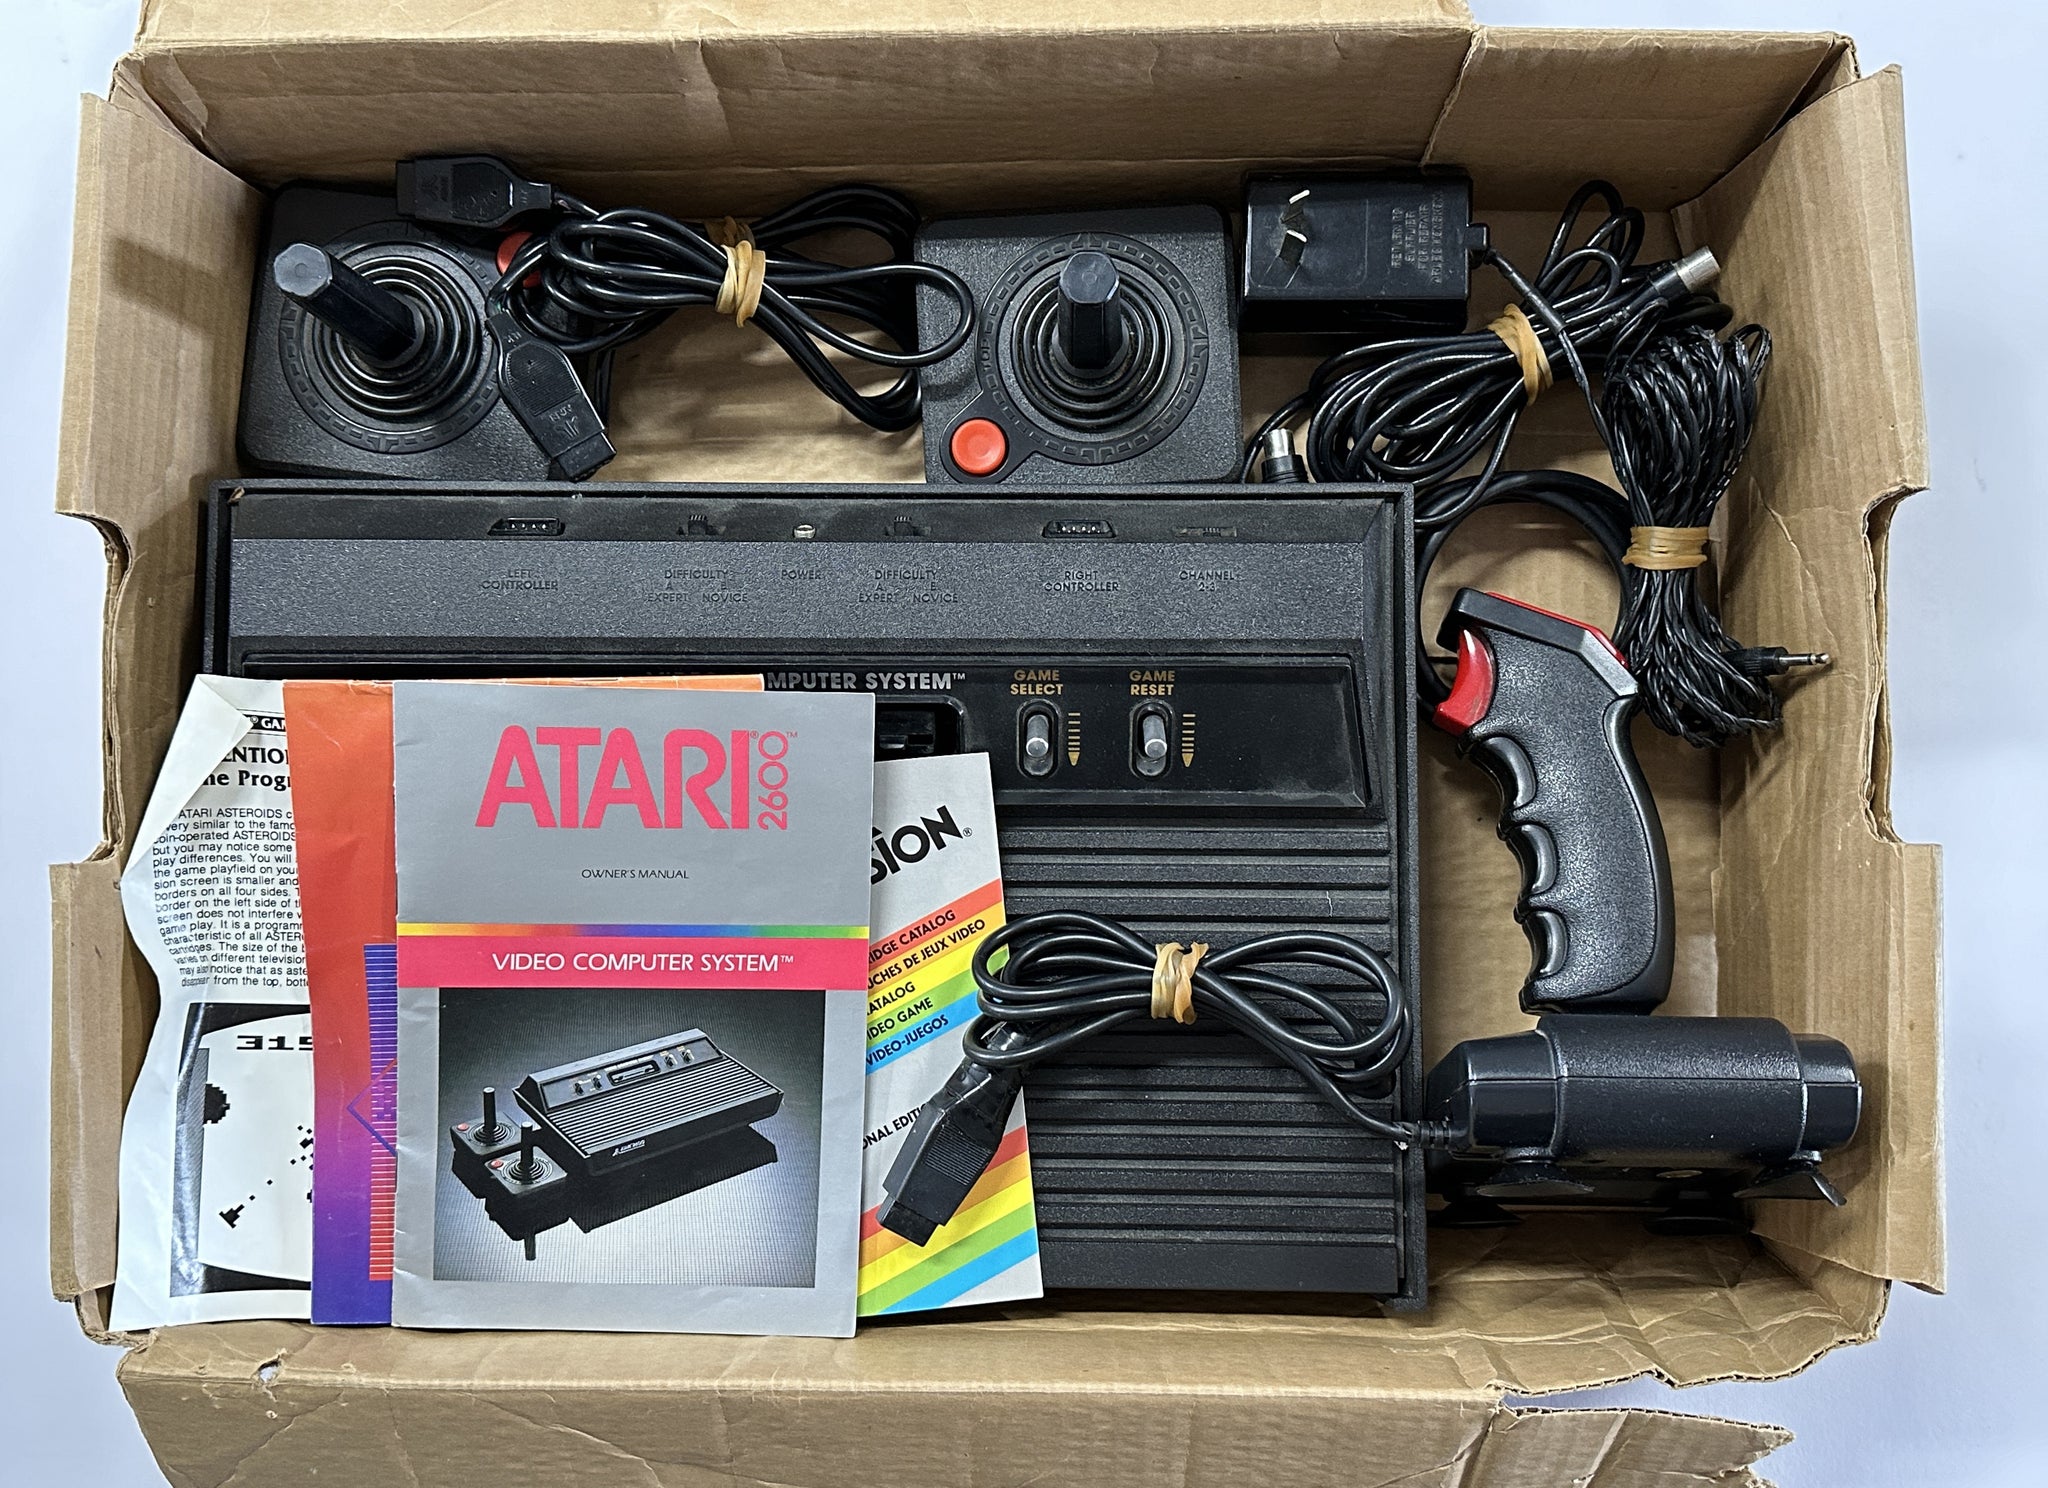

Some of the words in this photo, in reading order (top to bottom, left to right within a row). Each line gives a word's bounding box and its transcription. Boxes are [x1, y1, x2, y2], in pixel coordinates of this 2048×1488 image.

[507, 569, 533, 579] LEFT
[664, 569, 730, 579] DIFFICULTY
[781, 569, 821, 580] POWER
[874, 569, 937, 580] DIFFICULTY
[1065, 570, 1098, 580] RIGHT
[1179, 571, 1235, 581] CHANNEL
[481, 580, 558, 591] CONTROLLER
[1044, 582, 1119, 592] CONTROLLER
[649, 592, 690, 602] EXPERT
[702, 592, 748, 602] NOVICE
[913, 593, 958, 603] NOVICE
[1014, 669, 1060, 681] GAME
[1129, 670, 1175, 682] GAME
[1010, 683, 1063, 695] SELECT
[1130, 684, 1174, 696] RESET
[178, 808, 212, 819] ATARI
[216, 808, 282, 818] ASTEROIDS
[193, 820, 230, 830] similar
[234, 820, 245, 829] to
[249, 820, 266, 829] the
[153, 846, 170, 855] but
[174, 844, 194, 856] you
[198, 843, 223, 853] may
[226, 842, 260, 851] notice
[263, 843, 293, 852] some
[153, 857, 176, 867] play
[250, 853, 271, 863] You
[274, 854, 292, 863] will
[153, 869, 171, 879] the
[174, 866, 206, 878] game
[210, 864, 256, 875] playfield
[260, 866, 273, 874] on
[581, 869, 636, 879] OWNER'S
[638, 869, 689, 879] MANUAL
[154, 880, 176, 890] sion
[180, 877, 219, 887] screen
[223, 876, 232, 884] is
[236, 876, 275, 885] smaller
[155, 889, 197, 901] borders
[201, 888, 215, 896] on
[218, 886, 232, 895] all
[235, 887, 256, 896] four
[156, 900, 190, 913] border
[194, 900, 209, 908] on
[213, 898, 231, 907] the
[234, 898, 251, 907] left
[254, 898, 277, 907] side
[280, 899, 291, 908] of
[157, 911, 193, 924] screen
[196, 909, 224, 919] does
[227, 909, 244, 918] not
[248, 909, 294, 919] interfere
[159, 924, 186, 937] game
[220, 920, 228, 929] It
[232, 920, 241, 929] is
[898, 910, 956, 945] CATALOG
[164, 931, 232, 946] characteristic
[234, 932, 246, 941] of
[249, 932, 262, 941] all
[903, 954, 921, 969] DE
[921, 938, 949, 961] JEUX
[947, 919, 985, 944] VIDEO
[218, 941, 238, 951] The
[242, 942, 264, 951] size
[266, 942, 278, 952] of
[281, 943, 298, 952] the
[211, 953, 255, 963] different
[492, 952, 565, 971] VIDEO
[573, 952, 694, 971] COMPUTER
[210, 964, 242, 973] notice
[246, 965, 266, 974] that
[270, 967, 283, 975] as
[214, 976, 238, 985] from
[242, 976, 258, 986] the
[867, 981, 916, 1016] ATALOG
[897, 997, 933, 1022] GAME
[866, 1014, 949, 1066] VIDEO-JUEGOS
